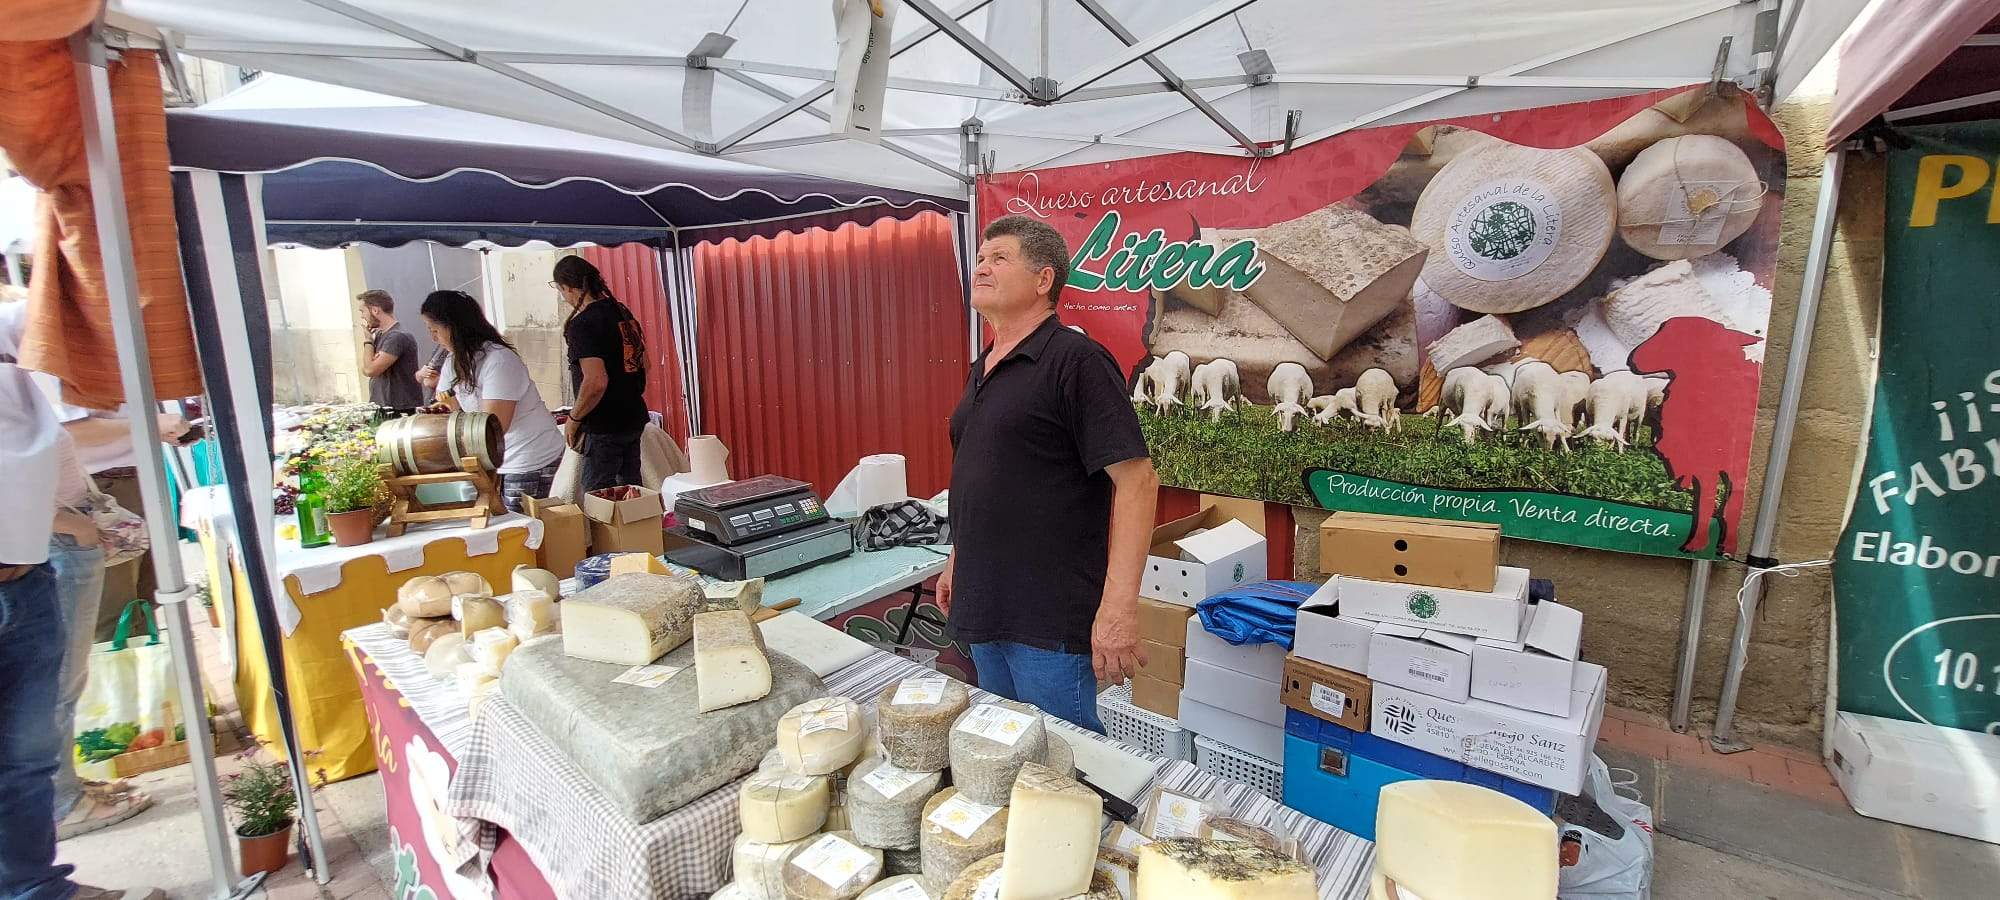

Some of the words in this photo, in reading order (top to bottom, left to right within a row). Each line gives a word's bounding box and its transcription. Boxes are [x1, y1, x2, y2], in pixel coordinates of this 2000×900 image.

[1007, 173, 1095, 218] Queso
[1102, 157, 1266, 206] artesanal
[1513, 183, 1530, 196] de
[1531, 188, 1545, 203] la
[1451, 183, 1509, 234] Artesanal
[1543, 203, 1560, 246] Litera
[1063, 210, 1267, 293] Litera
[1451, 237, 1476, 269] Queso
[1327, 474, 1428, 505] Producción
[1431, 492, 1500, 516] propia.
[1510, 498, 1577, 524] Venta
[1585, 508, 1678, 538] directa.
[1503, 748, 1514, 757] DE
[1529, 733, 1567, 753] Sanz
